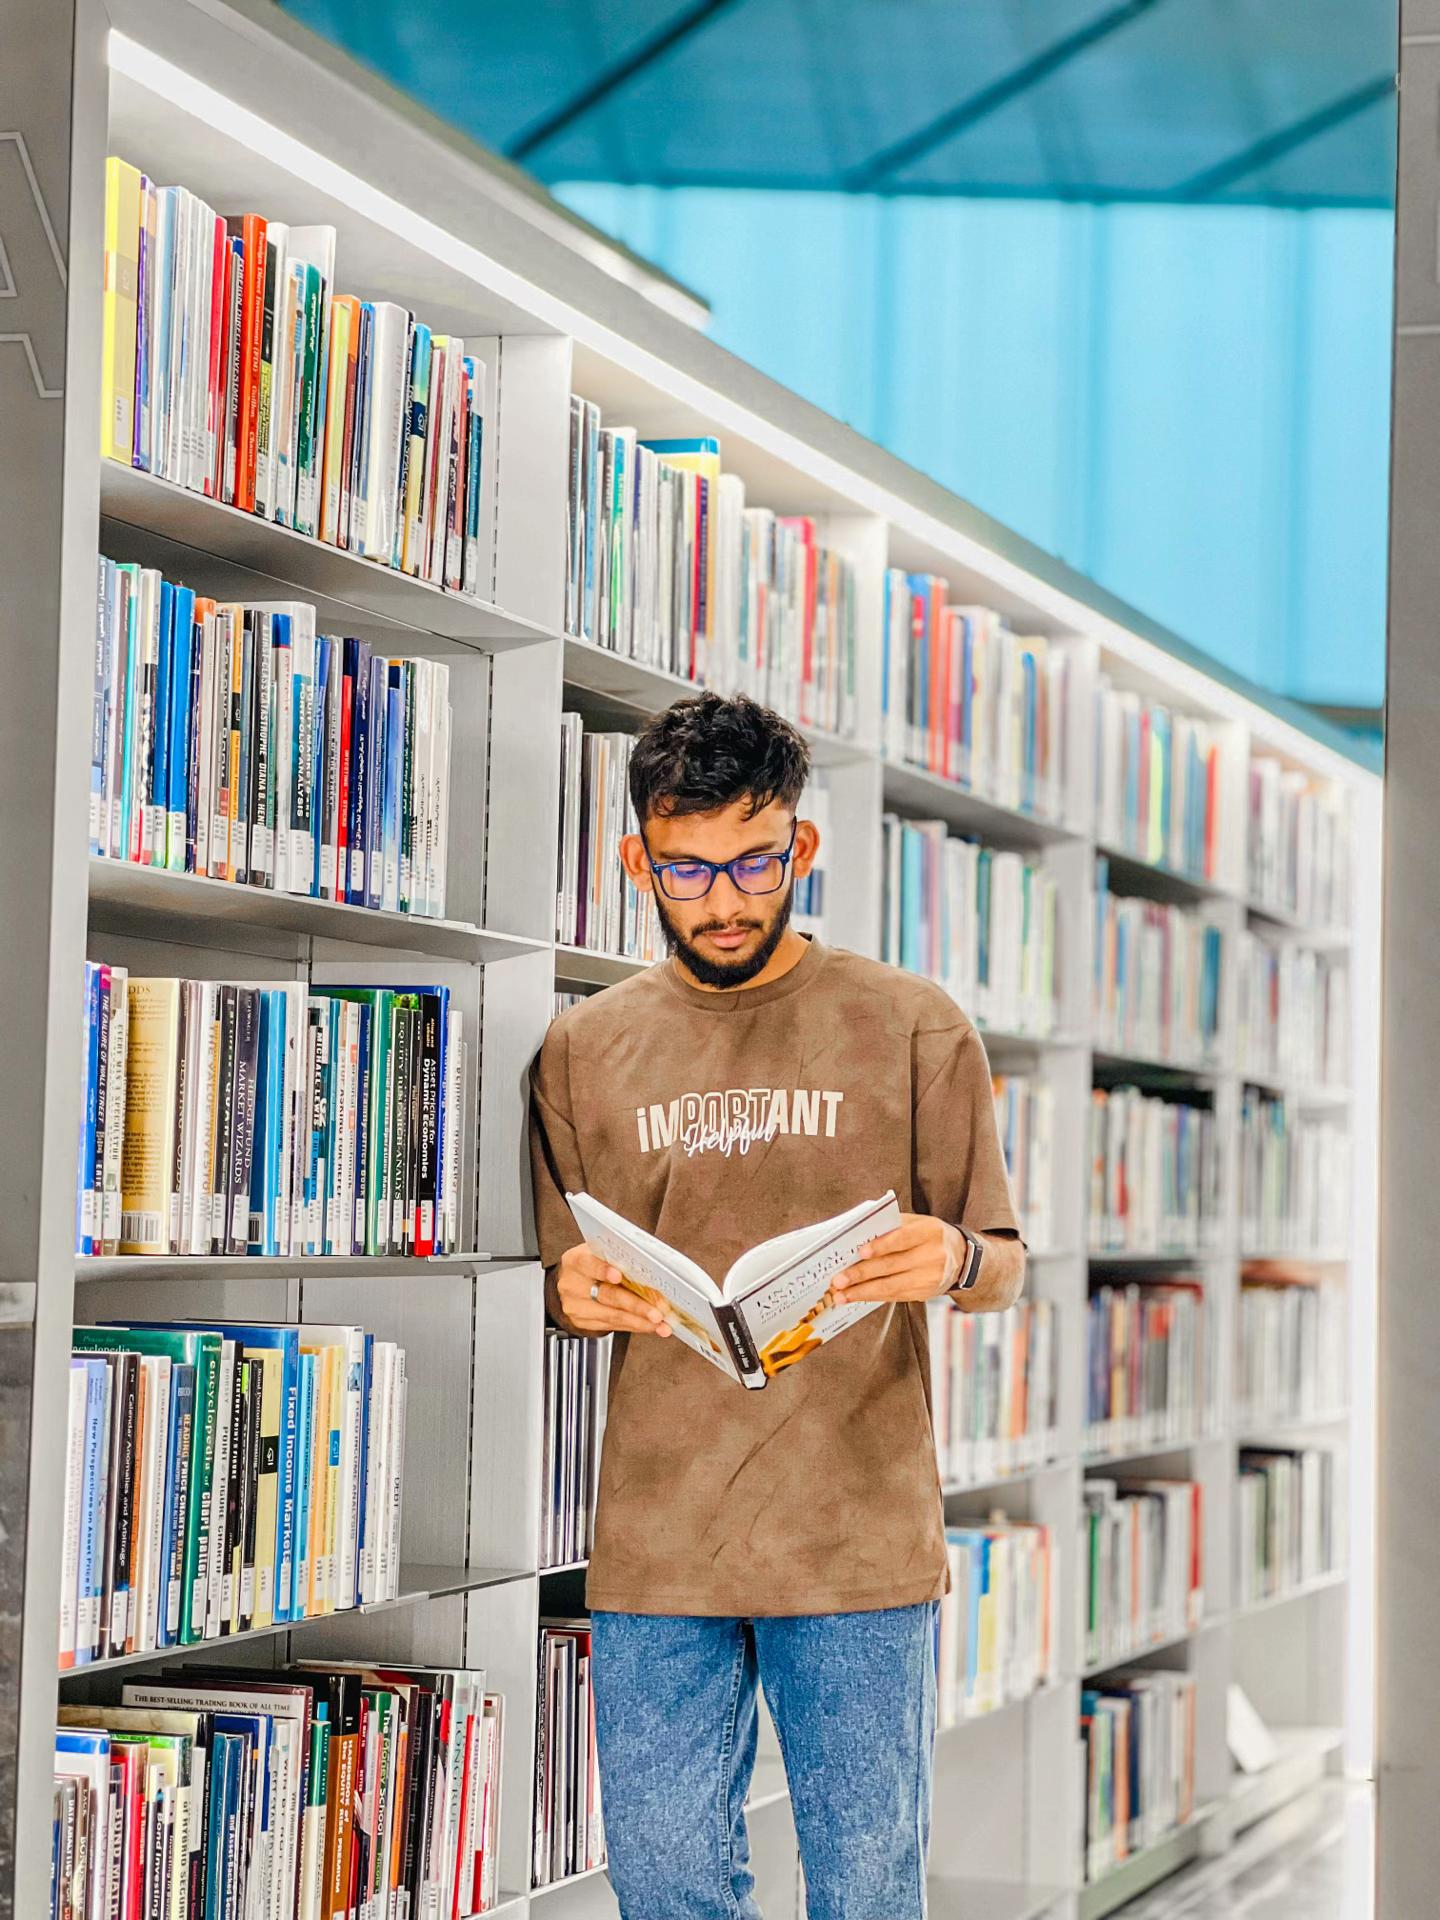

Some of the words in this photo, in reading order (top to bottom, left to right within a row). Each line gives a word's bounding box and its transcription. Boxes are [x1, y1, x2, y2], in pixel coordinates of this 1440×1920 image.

[254, 296, 262, 345] Investment
[232, 350, 240, 418] INVESTMENT
[259, 693, 268, 756] CATASTROPHE
[298, 682, 306, 754] PORTFOLIO
[296, 757, 304, 817] ANALYSIS
[100, 1050, 106, 1061] OF
[315, 1032, 323, 1087] MICHAEL
[237, 1060, 246, 1118] MARKET
[246, 1079, 254, 1125] HEDGE
[422, 1059, 430, 1110] Dynamic
[223, 1082, 231, 1148] QUANT
[234, 1122, 244, 1184] WIZARDS
[204, 1360, 217, 1471] encyclopedia
[288, 1387, 296, 1428] Fixed
[182, 1414, 191, 1458] READING
[88, 1442, 97, 1508] Perspectives
[124, 1441, 132, 1494] Anomalies
[204, 1476, 209, 1486] of
[286, 1435, 295, 1494] Income
[88, 1511, 92, 1523] on
[178, 1494, 186, 1537] CHARTS
[200, 1491, 211, 1531] chart
[282, 1499, 292, 1566] Markets
[120, 1518, 128, 1566] Arbitrage
[134, 1694, 148, 1702] THE
[150, 1696, 194, 1706] BEST-SELLING
[196, 1699, 227, 1707] TRADING
[345, 1740, 353, 1806] HANDBOOK
[381, 1738, 389, 1784] Money
[453, 1721, 463, 1780] LONG
[114, 1808, 123, 1857] BOND
[183, 1801, 188, 1814] of
[345, 1809, 350, 1822] of
[378, 1788, 386, 1836] School
[66, 1826, 74, 1877] ANALYTICS
[227, 1833, 235, 1894] Asset-Backed
[111, 1863, 121, 1915] MATH
[152, 1853, 162, 1916] Investing
